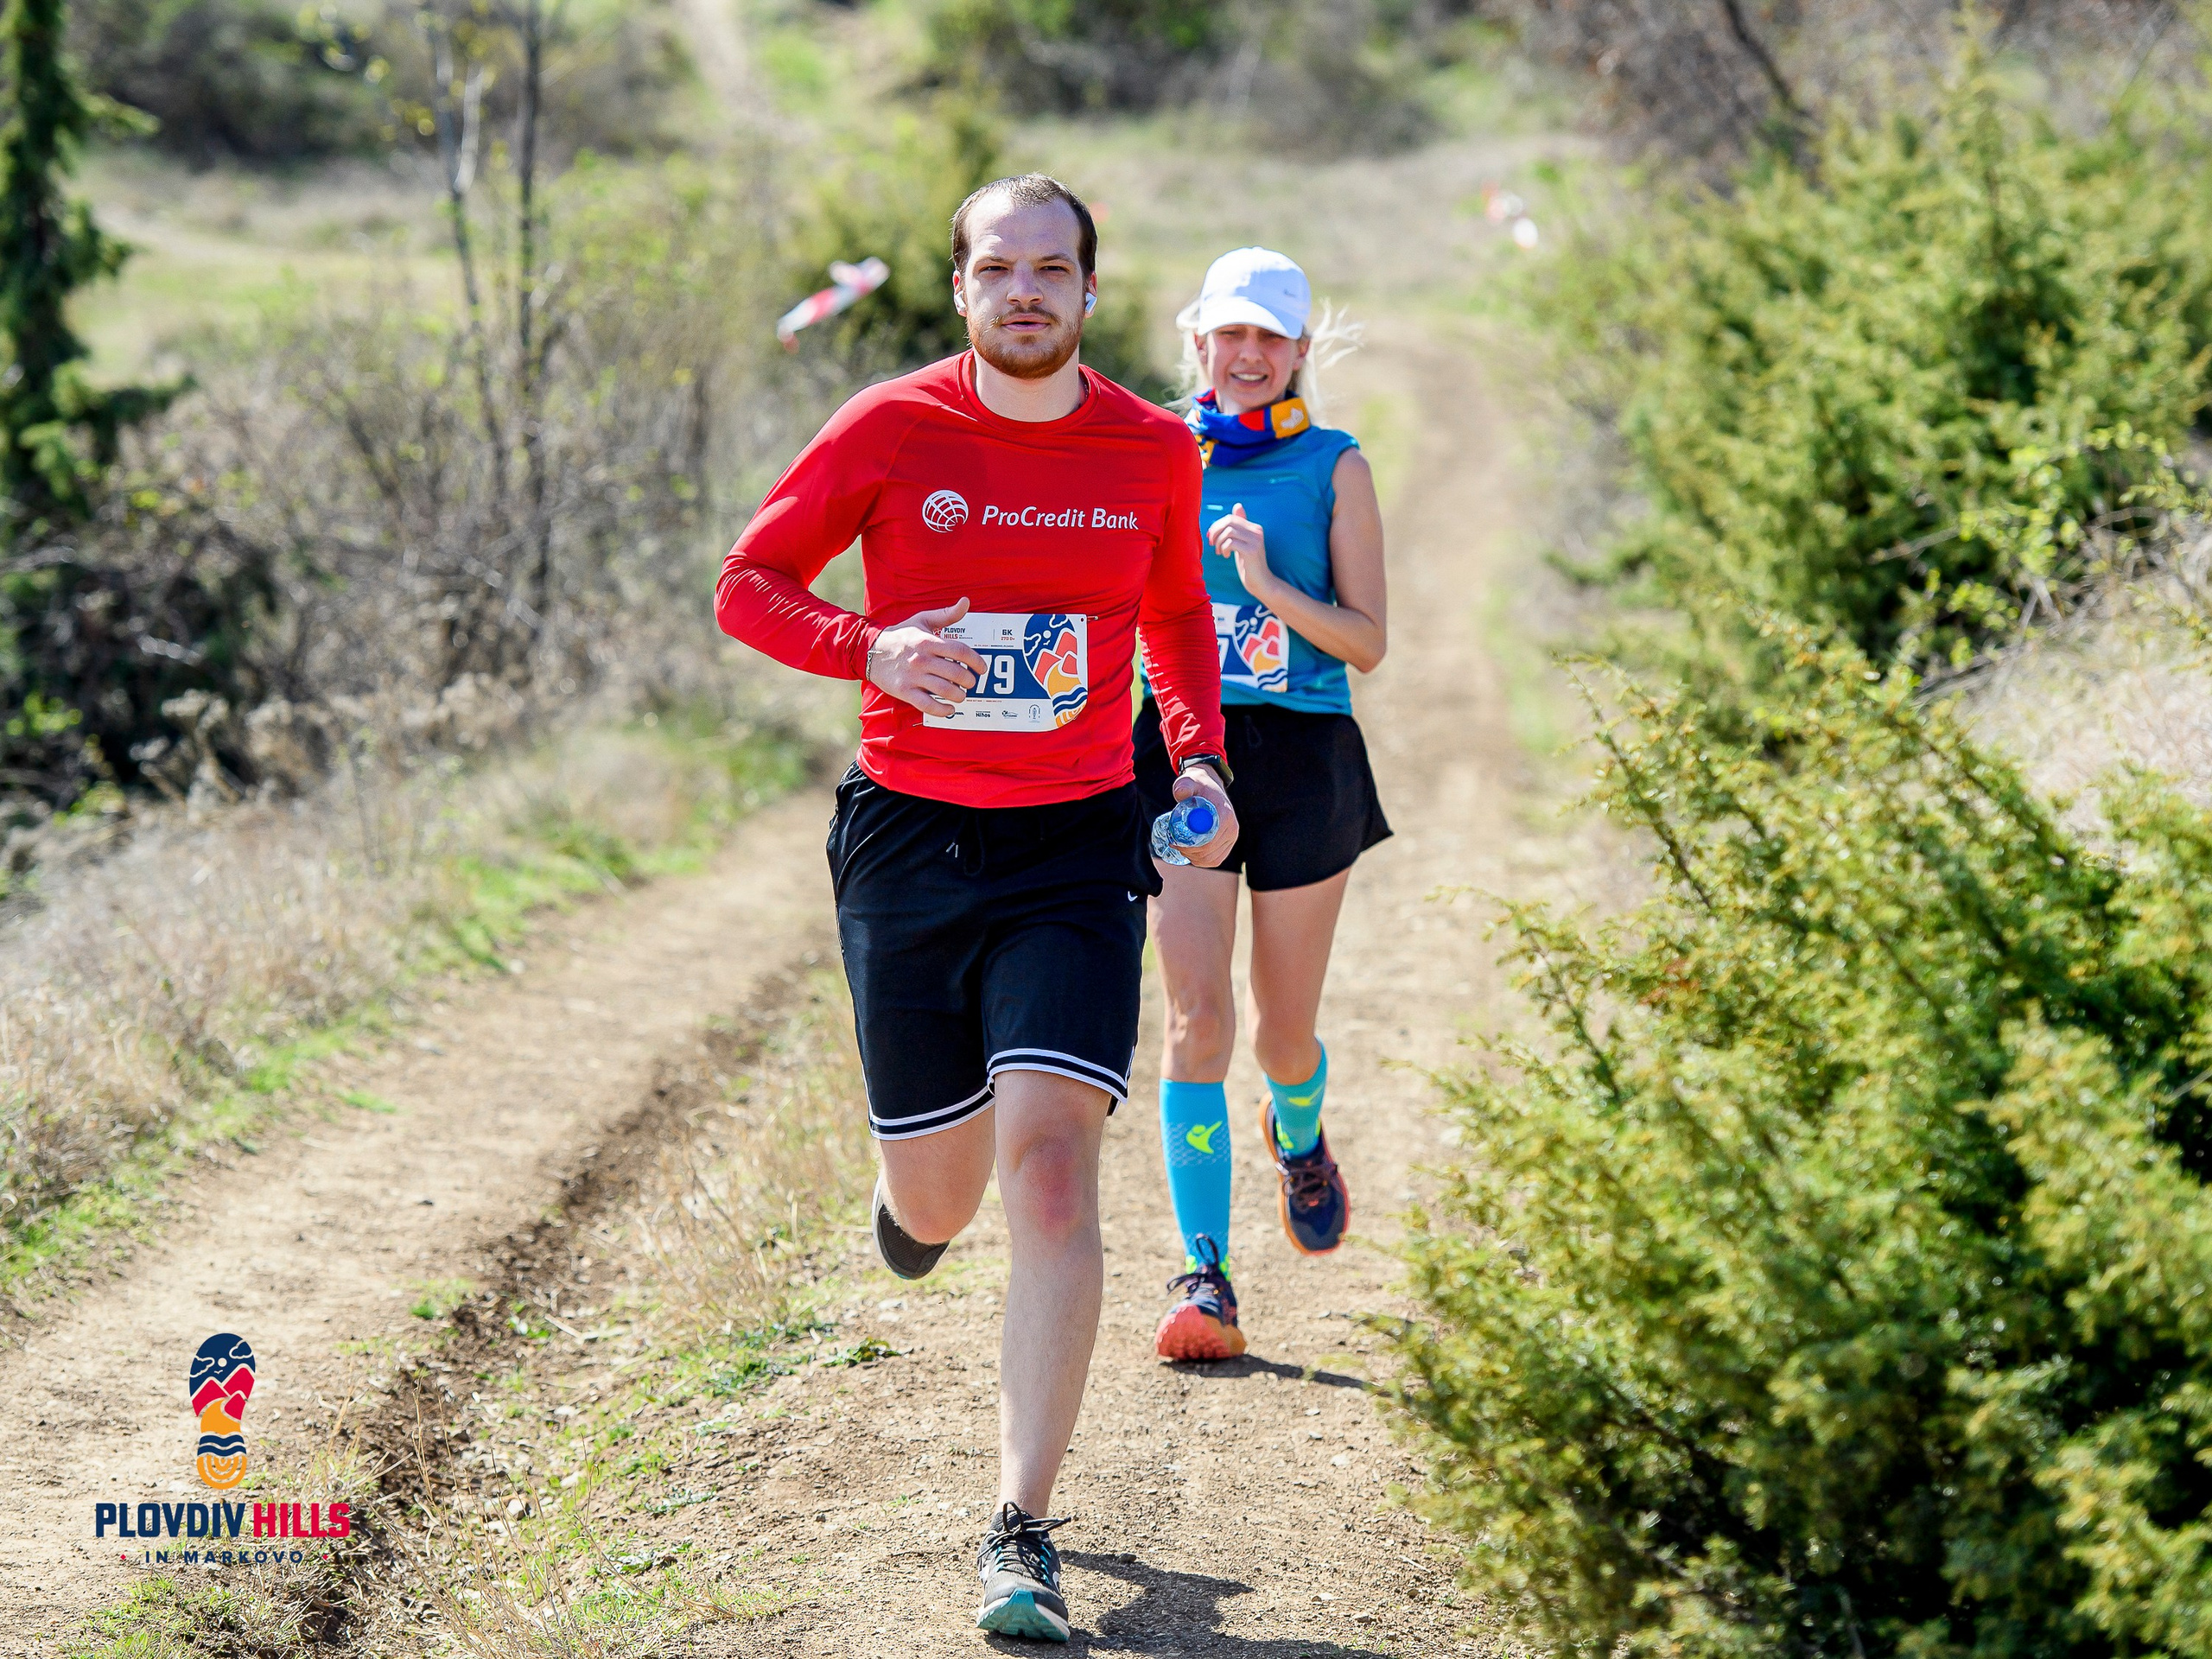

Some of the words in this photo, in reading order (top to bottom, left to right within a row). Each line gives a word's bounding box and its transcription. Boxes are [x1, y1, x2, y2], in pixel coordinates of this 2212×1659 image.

[982, 505, 1085, 527] ProCredit
[1091, 507, 1139, 530] Bank
[944, 654, 1015, 695] 79
